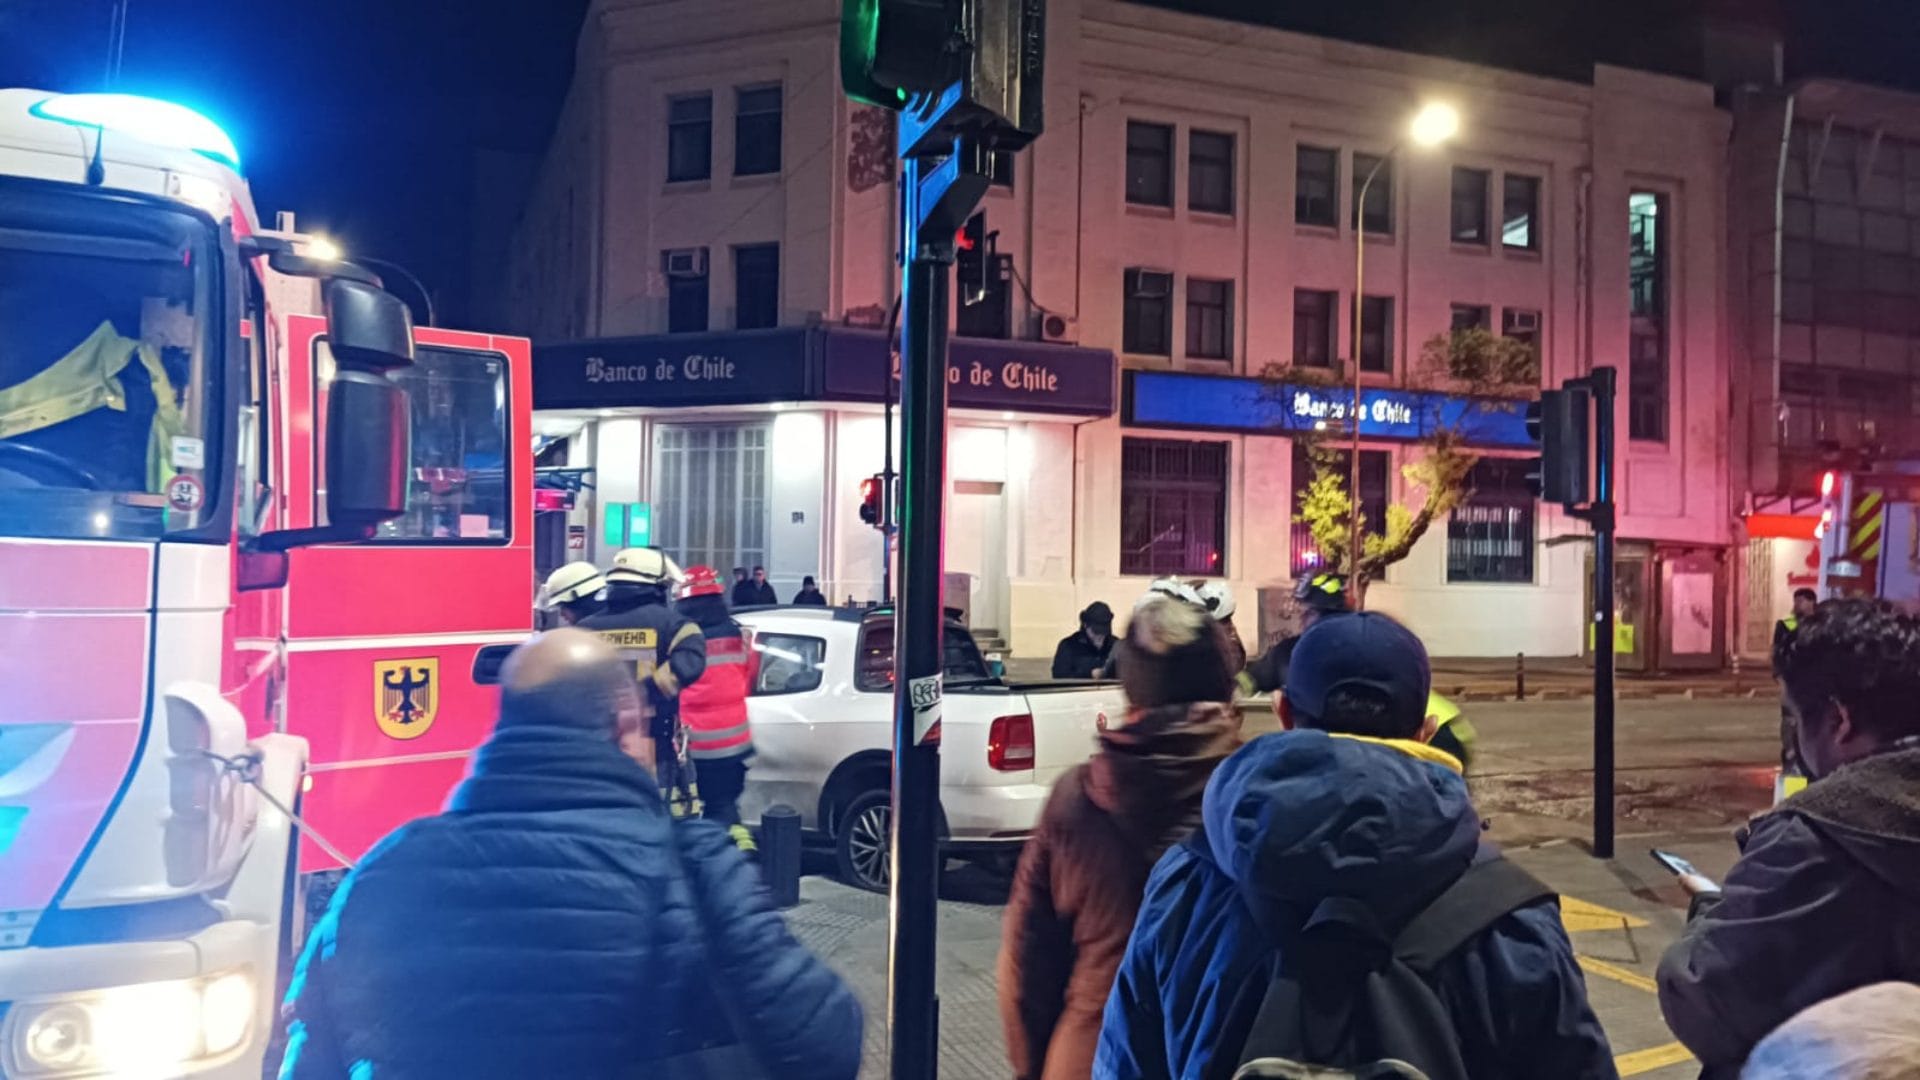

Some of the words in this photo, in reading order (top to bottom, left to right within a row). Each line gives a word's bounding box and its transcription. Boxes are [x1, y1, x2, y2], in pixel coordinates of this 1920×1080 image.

[585, 357, 648, 383] Banco
[655, 358, 675, 381] de
[683, 355, 735, 381] Chile
[970, 361, 993, 386] de
[1002, 362, 1058, 392] Chile
[1372, 399, 1411, 424] Chile
